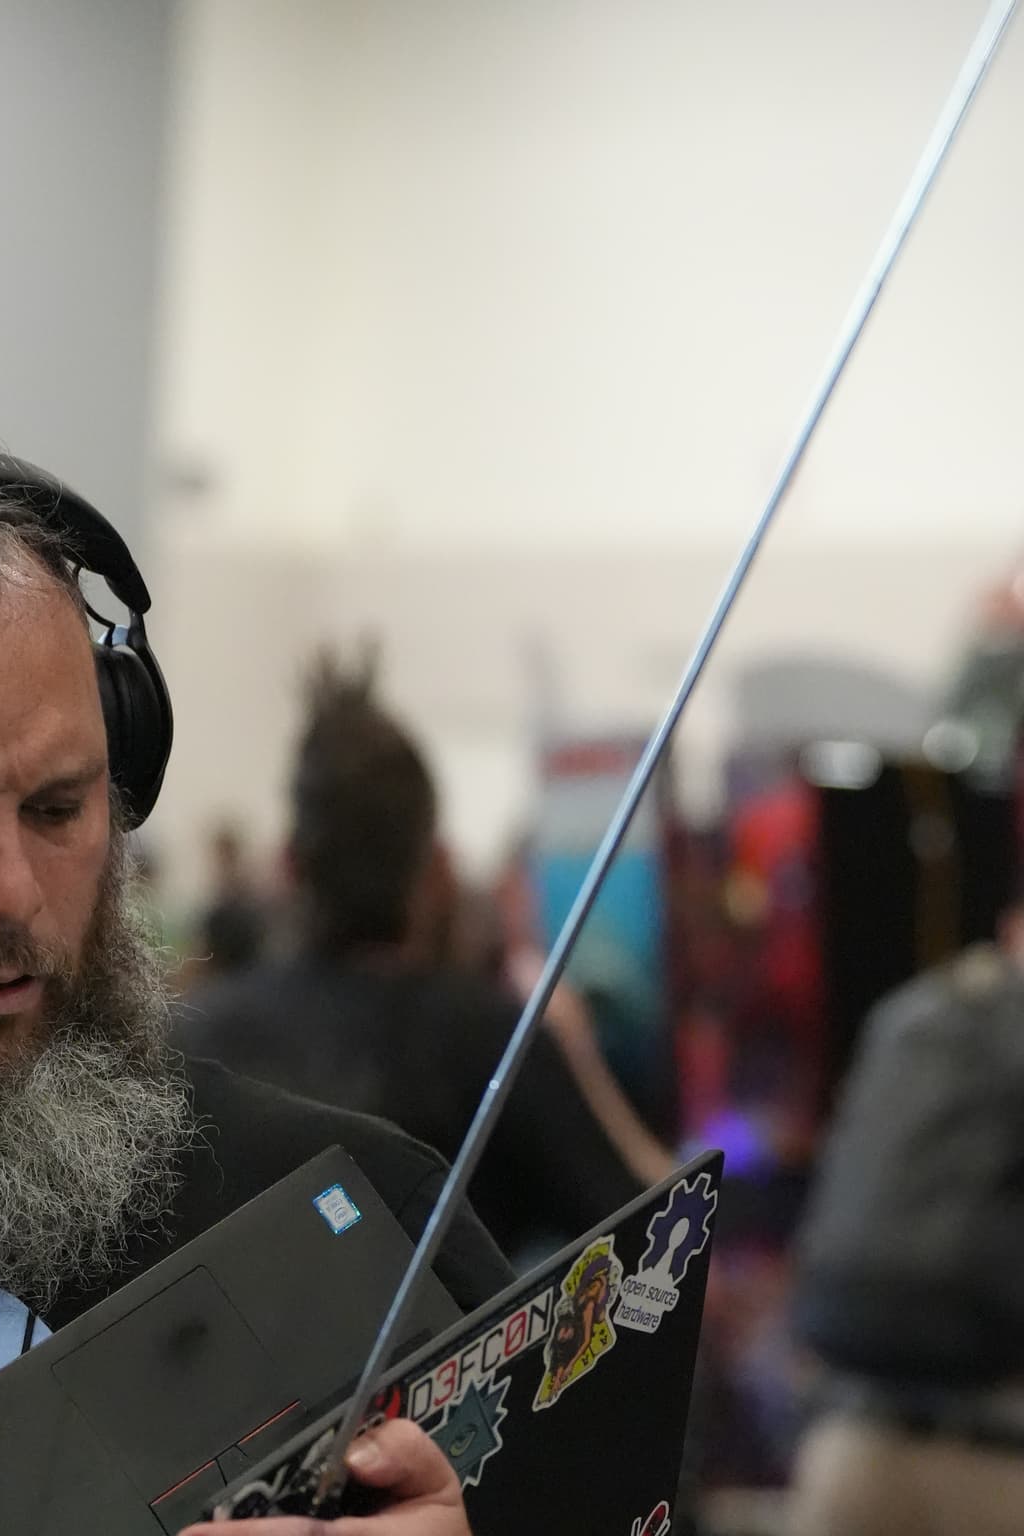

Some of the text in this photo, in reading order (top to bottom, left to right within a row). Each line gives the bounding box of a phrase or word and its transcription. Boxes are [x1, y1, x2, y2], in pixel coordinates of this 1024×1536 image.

[622, 1278, 677, 1305] open source
[617, 1303, 660, 1328] hardware
